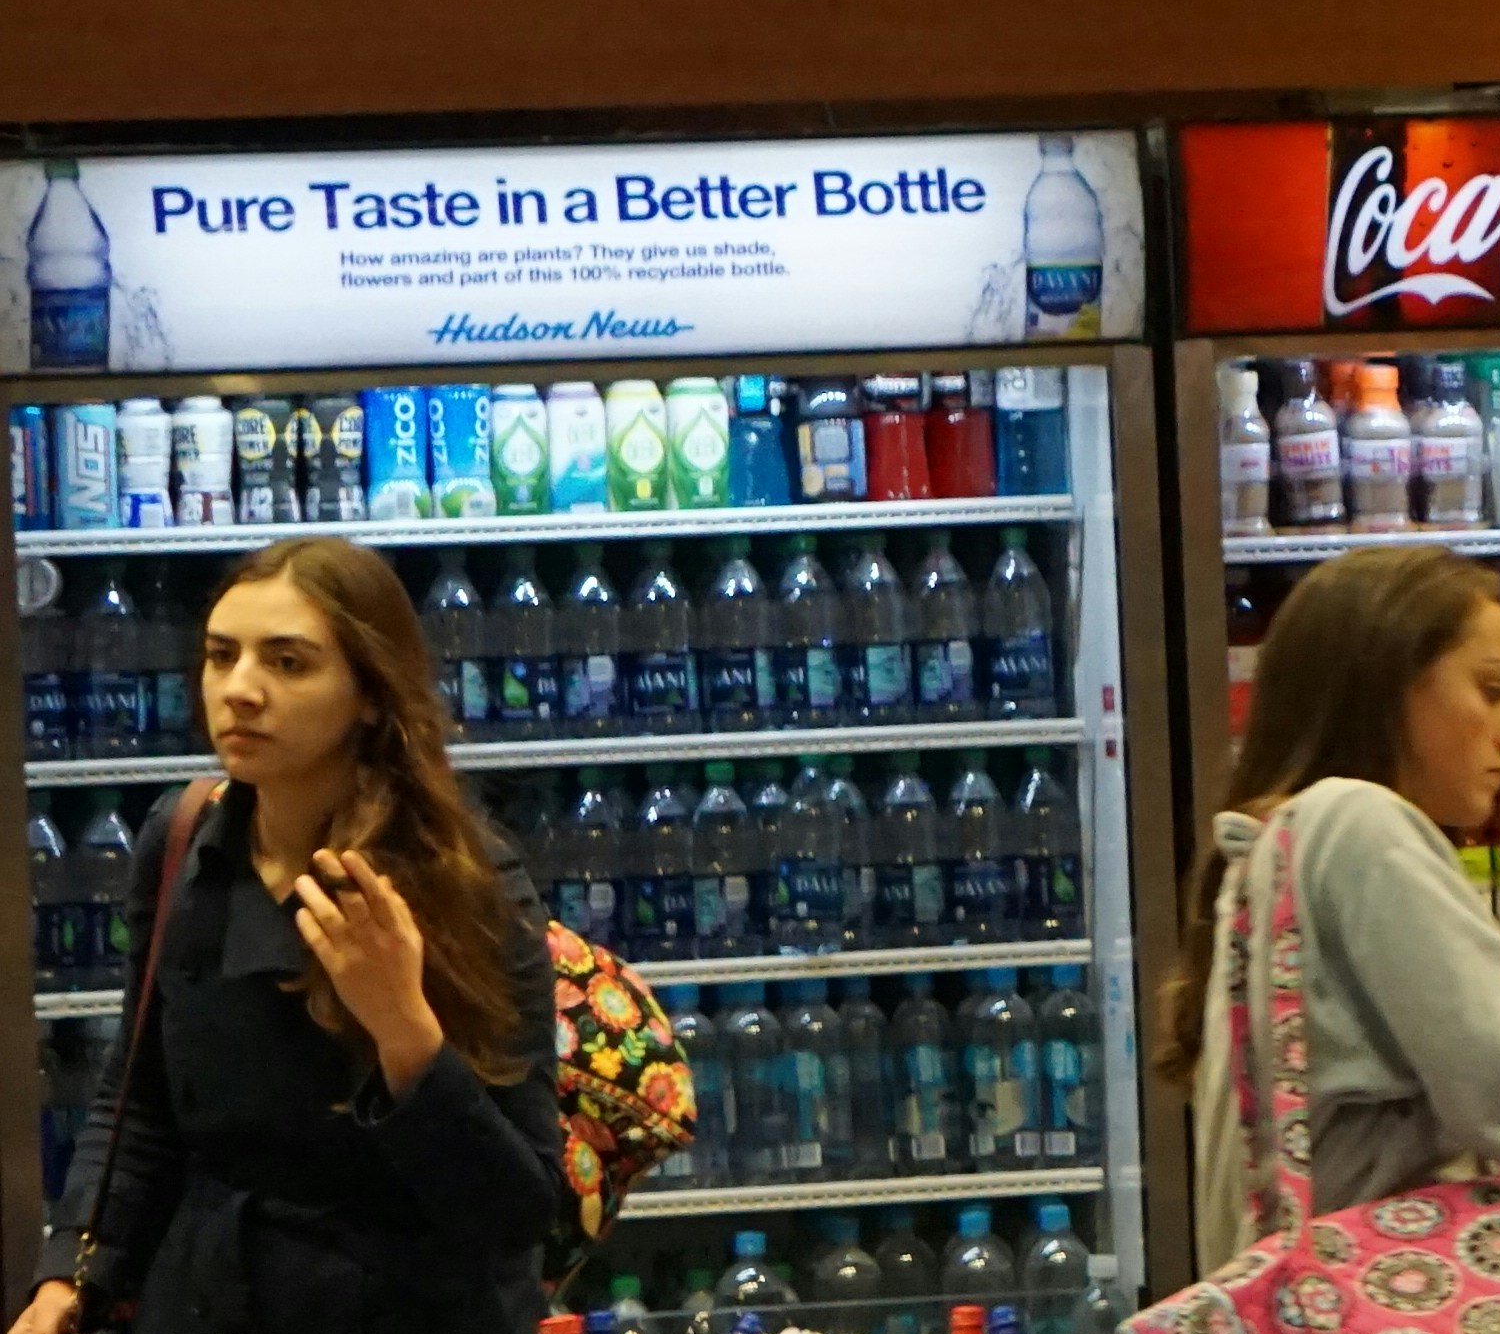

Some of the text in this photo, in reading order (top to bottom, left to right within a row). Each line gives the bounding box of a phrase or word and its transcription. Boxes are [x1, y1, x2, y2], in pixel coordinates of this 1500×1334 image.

[151, 164, 988, 236] Pure Taste in a Better Bottle
[340, 240, 777, 269] How amazing are plants? They give us shade,
[340, 259, 792, 288] flowers and part of this 100% recyclable bottle.
[427, 310, 694, 345] Hudson News
[394, 396, 416, 466] zico
